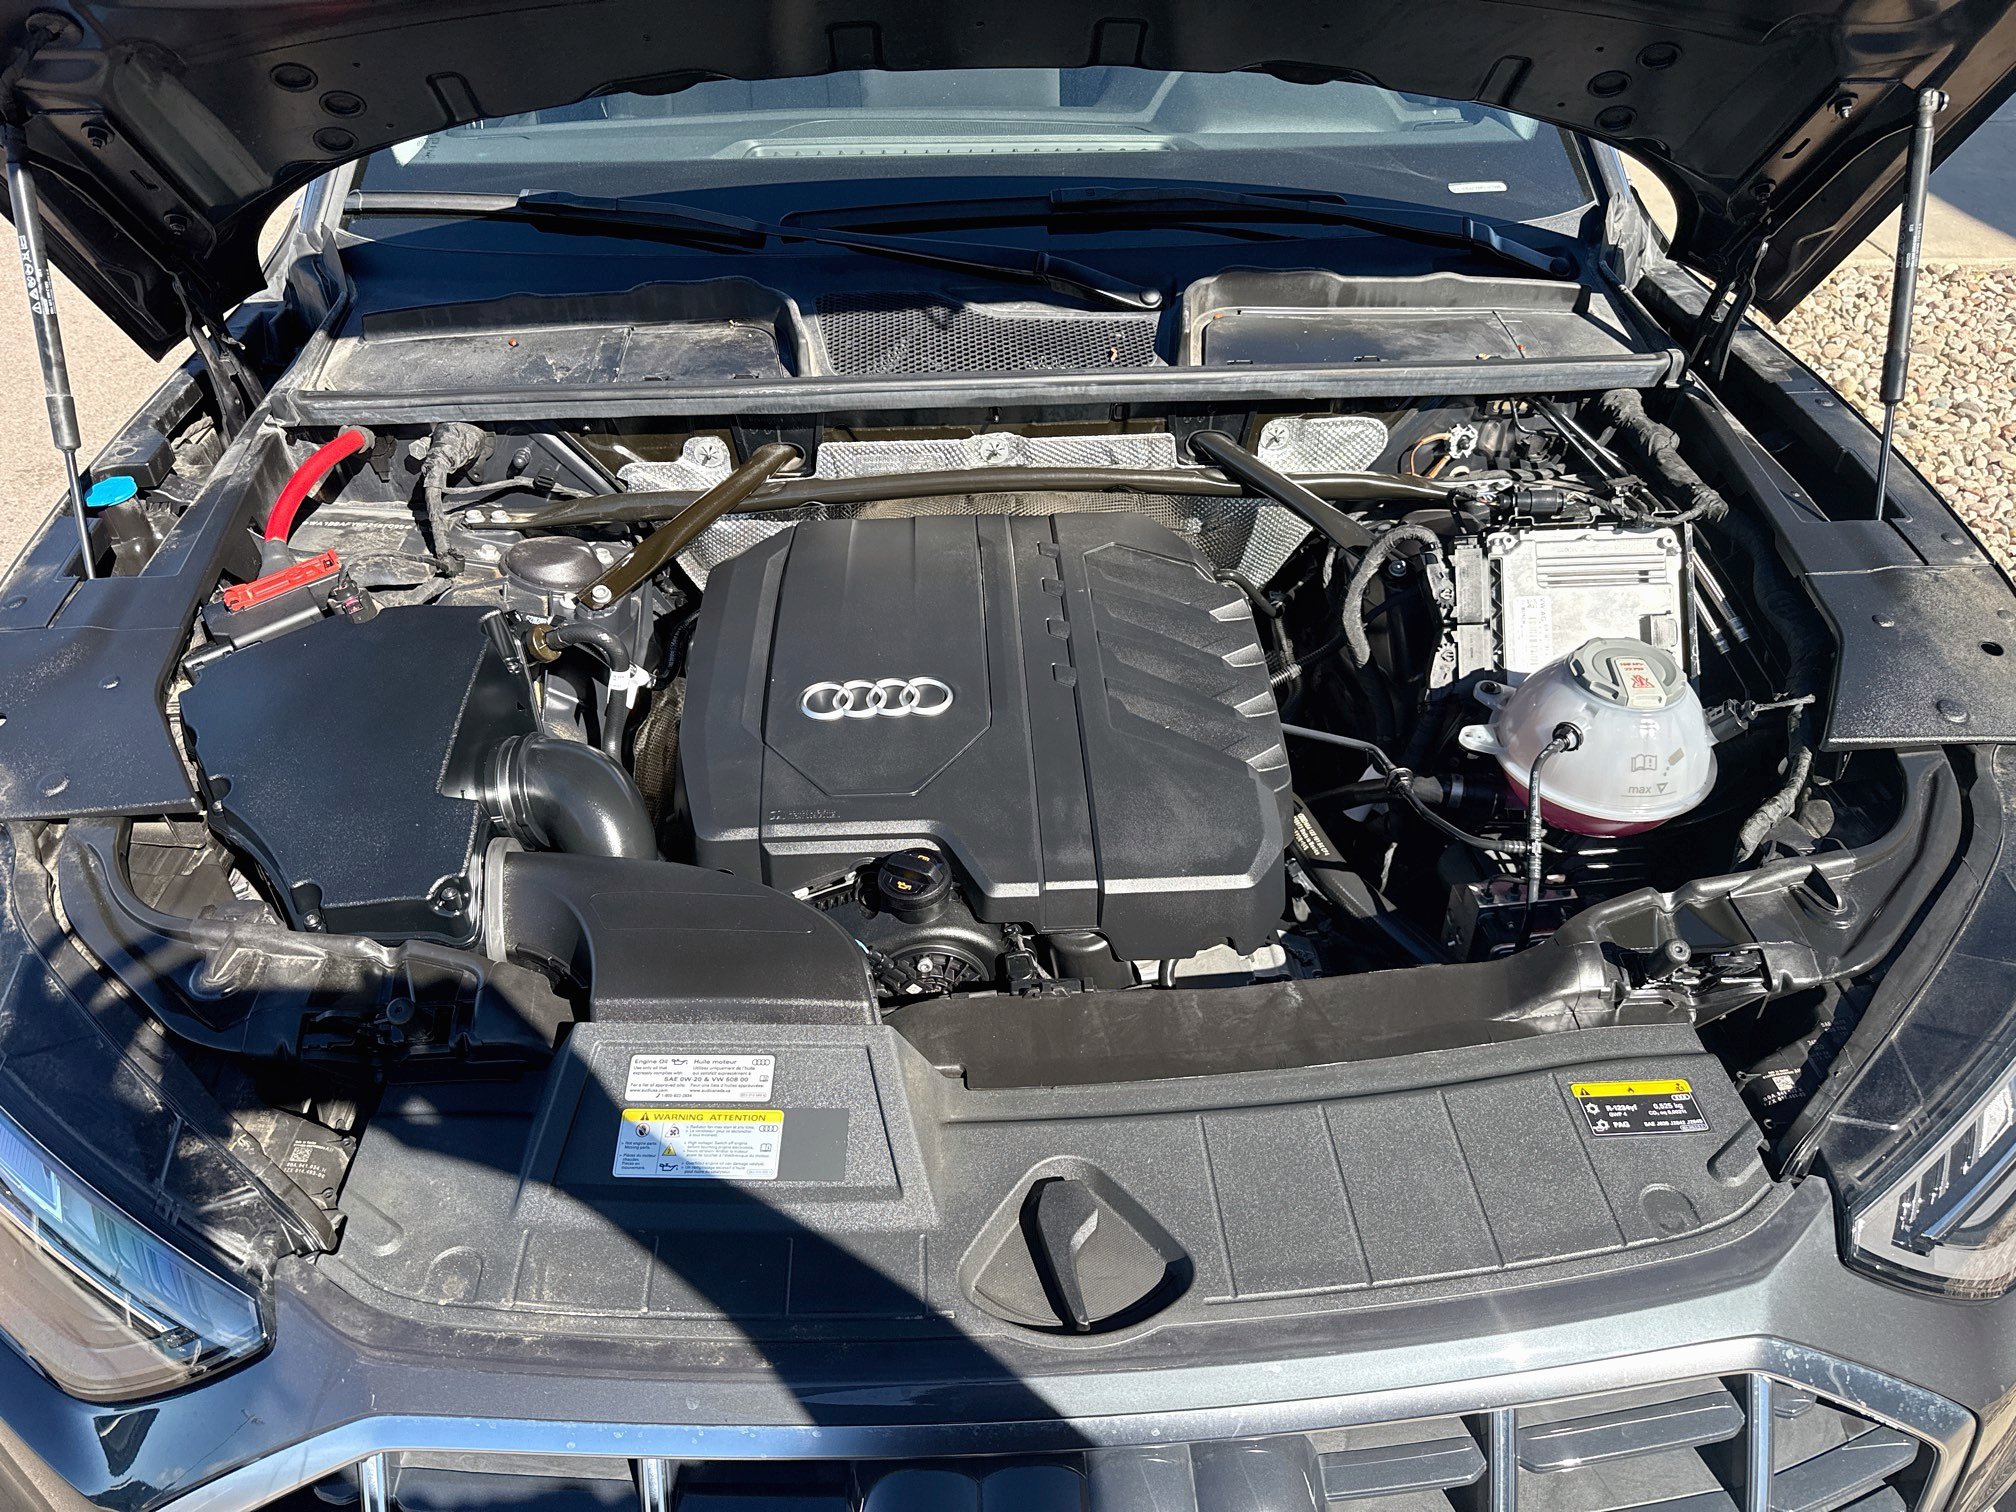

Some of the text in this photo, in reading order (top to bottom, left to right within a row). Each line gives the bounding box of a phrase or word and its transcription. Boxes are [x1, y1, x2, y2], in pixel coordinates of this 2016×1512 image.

[1628, 786, 1652, 794] max
[1606, 1104, 1638, 1112] R-1234yf
[1674, 1102, 1684, 1110] kg
